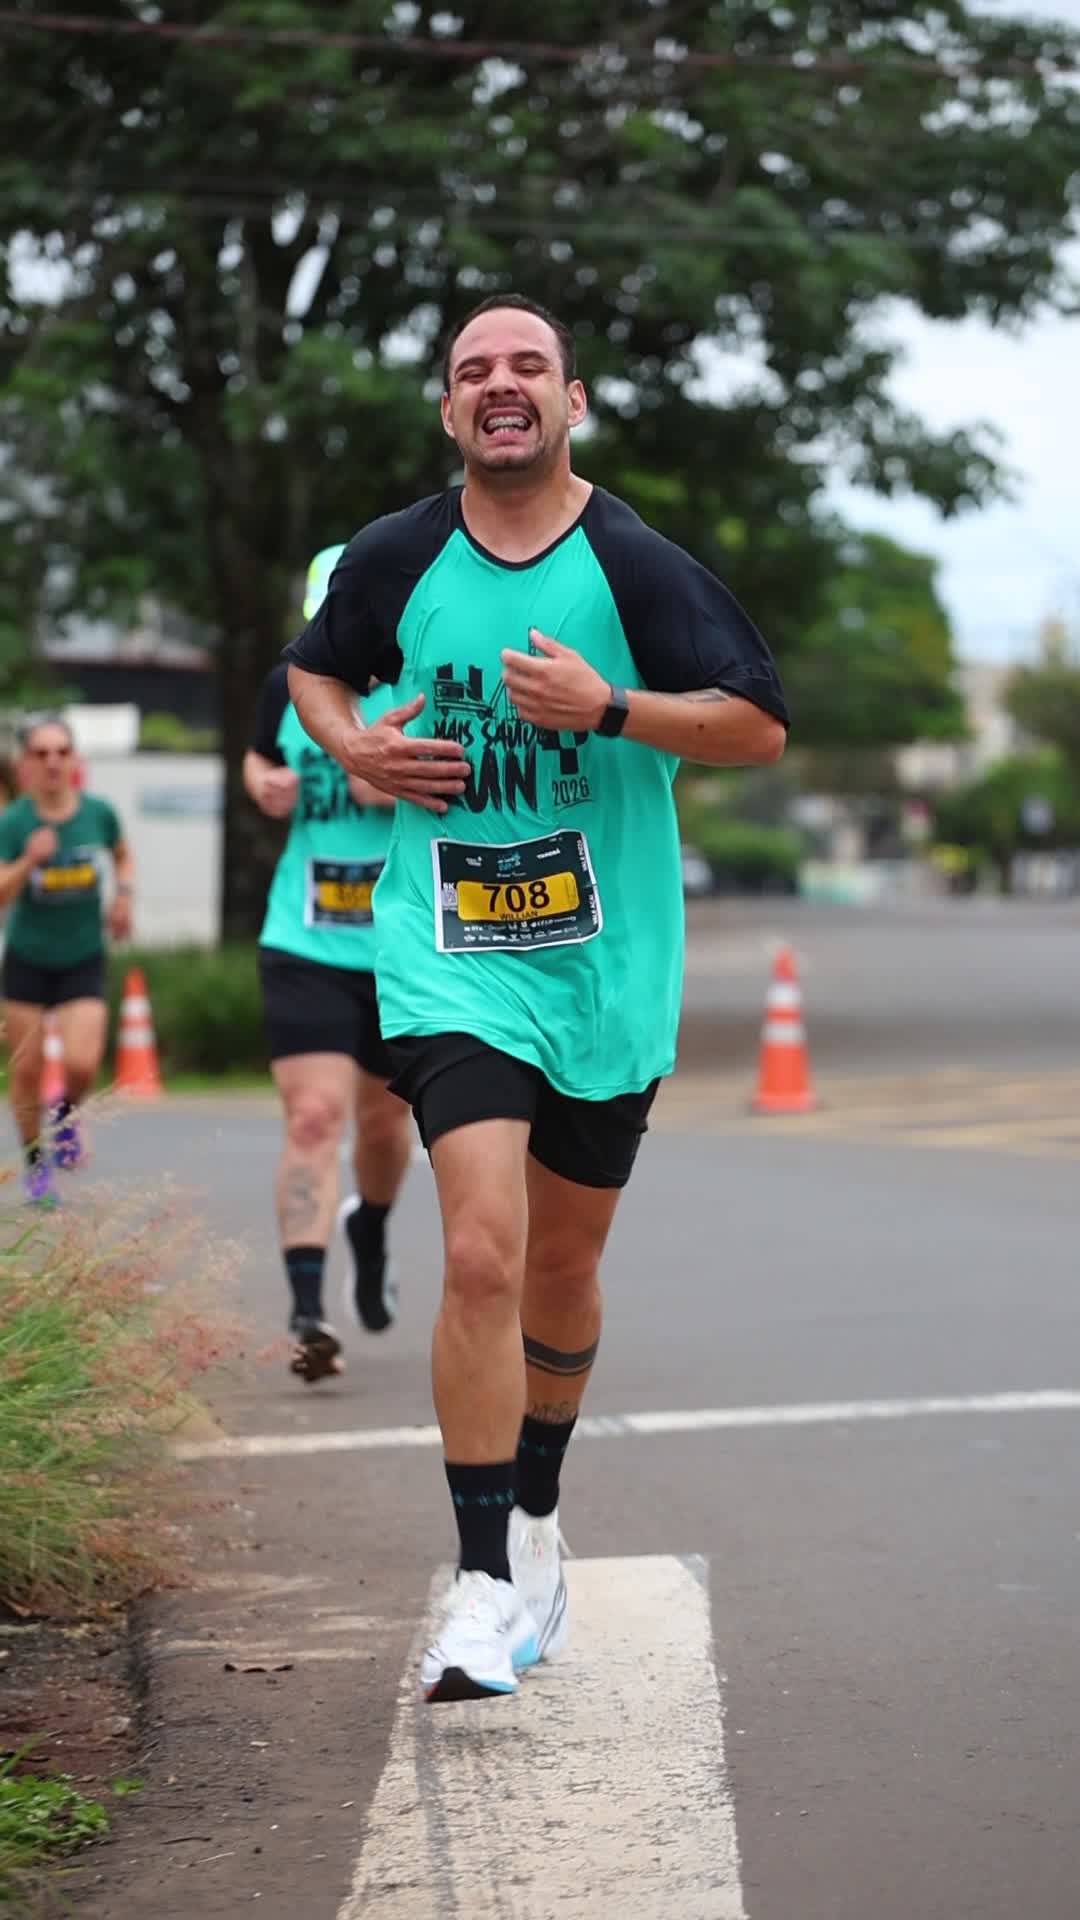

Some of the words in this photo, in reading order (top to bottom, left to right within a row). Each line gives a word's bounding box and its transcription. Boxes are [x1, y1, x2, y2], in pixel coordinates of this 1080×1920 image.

[433, 718, 474, 748] MAIS
[438, 747, 538, 815] UN
[552, 776, 590, 806] 2026
[482, 880, 550, 913] 708
[499, 910, 539, 921] WILLIAN
